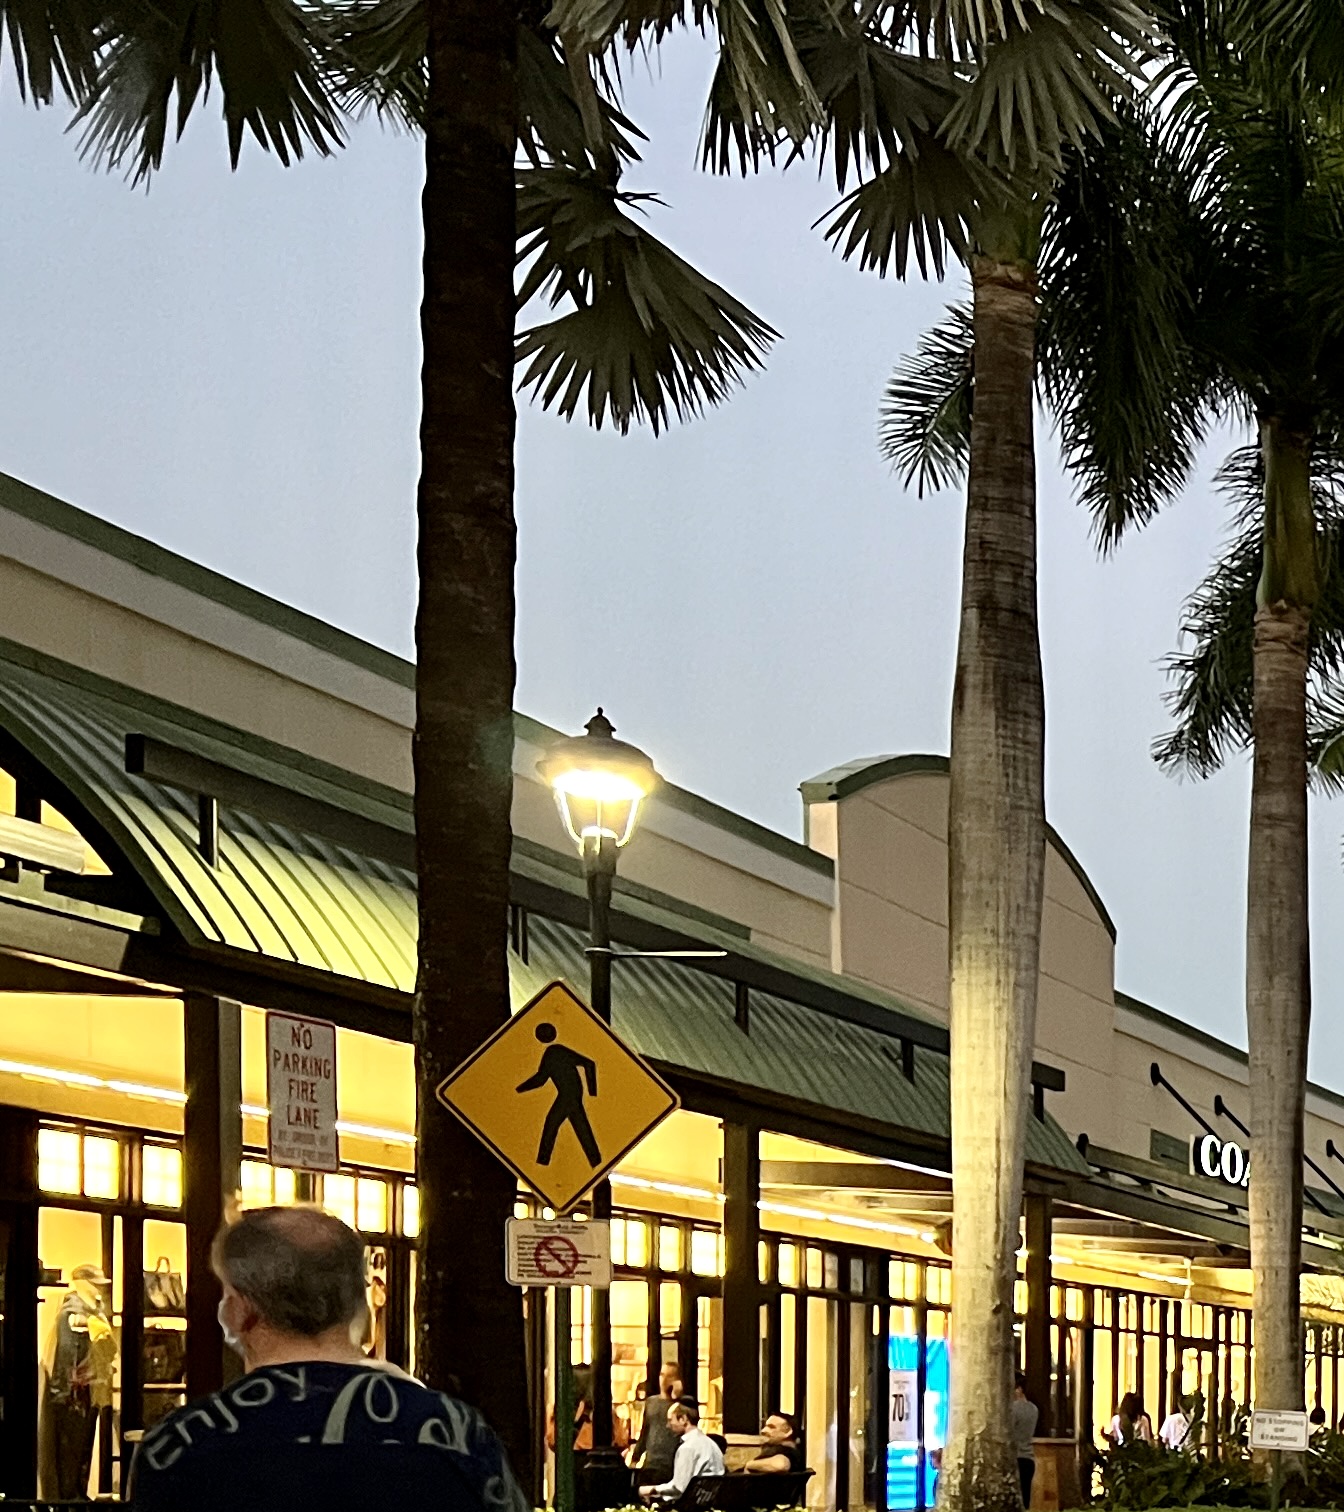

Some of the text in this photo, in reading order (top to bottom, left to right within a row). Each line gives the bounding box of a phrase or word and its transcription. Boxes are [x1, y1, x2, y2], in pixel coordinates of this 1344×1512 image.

[291, 1025, 313, 1050] NO
[273, 1049, 331, 1079] PARKING
[288, 1079, 318, 1104] FIRE
[287, 1104, 320, 1130] LANE
